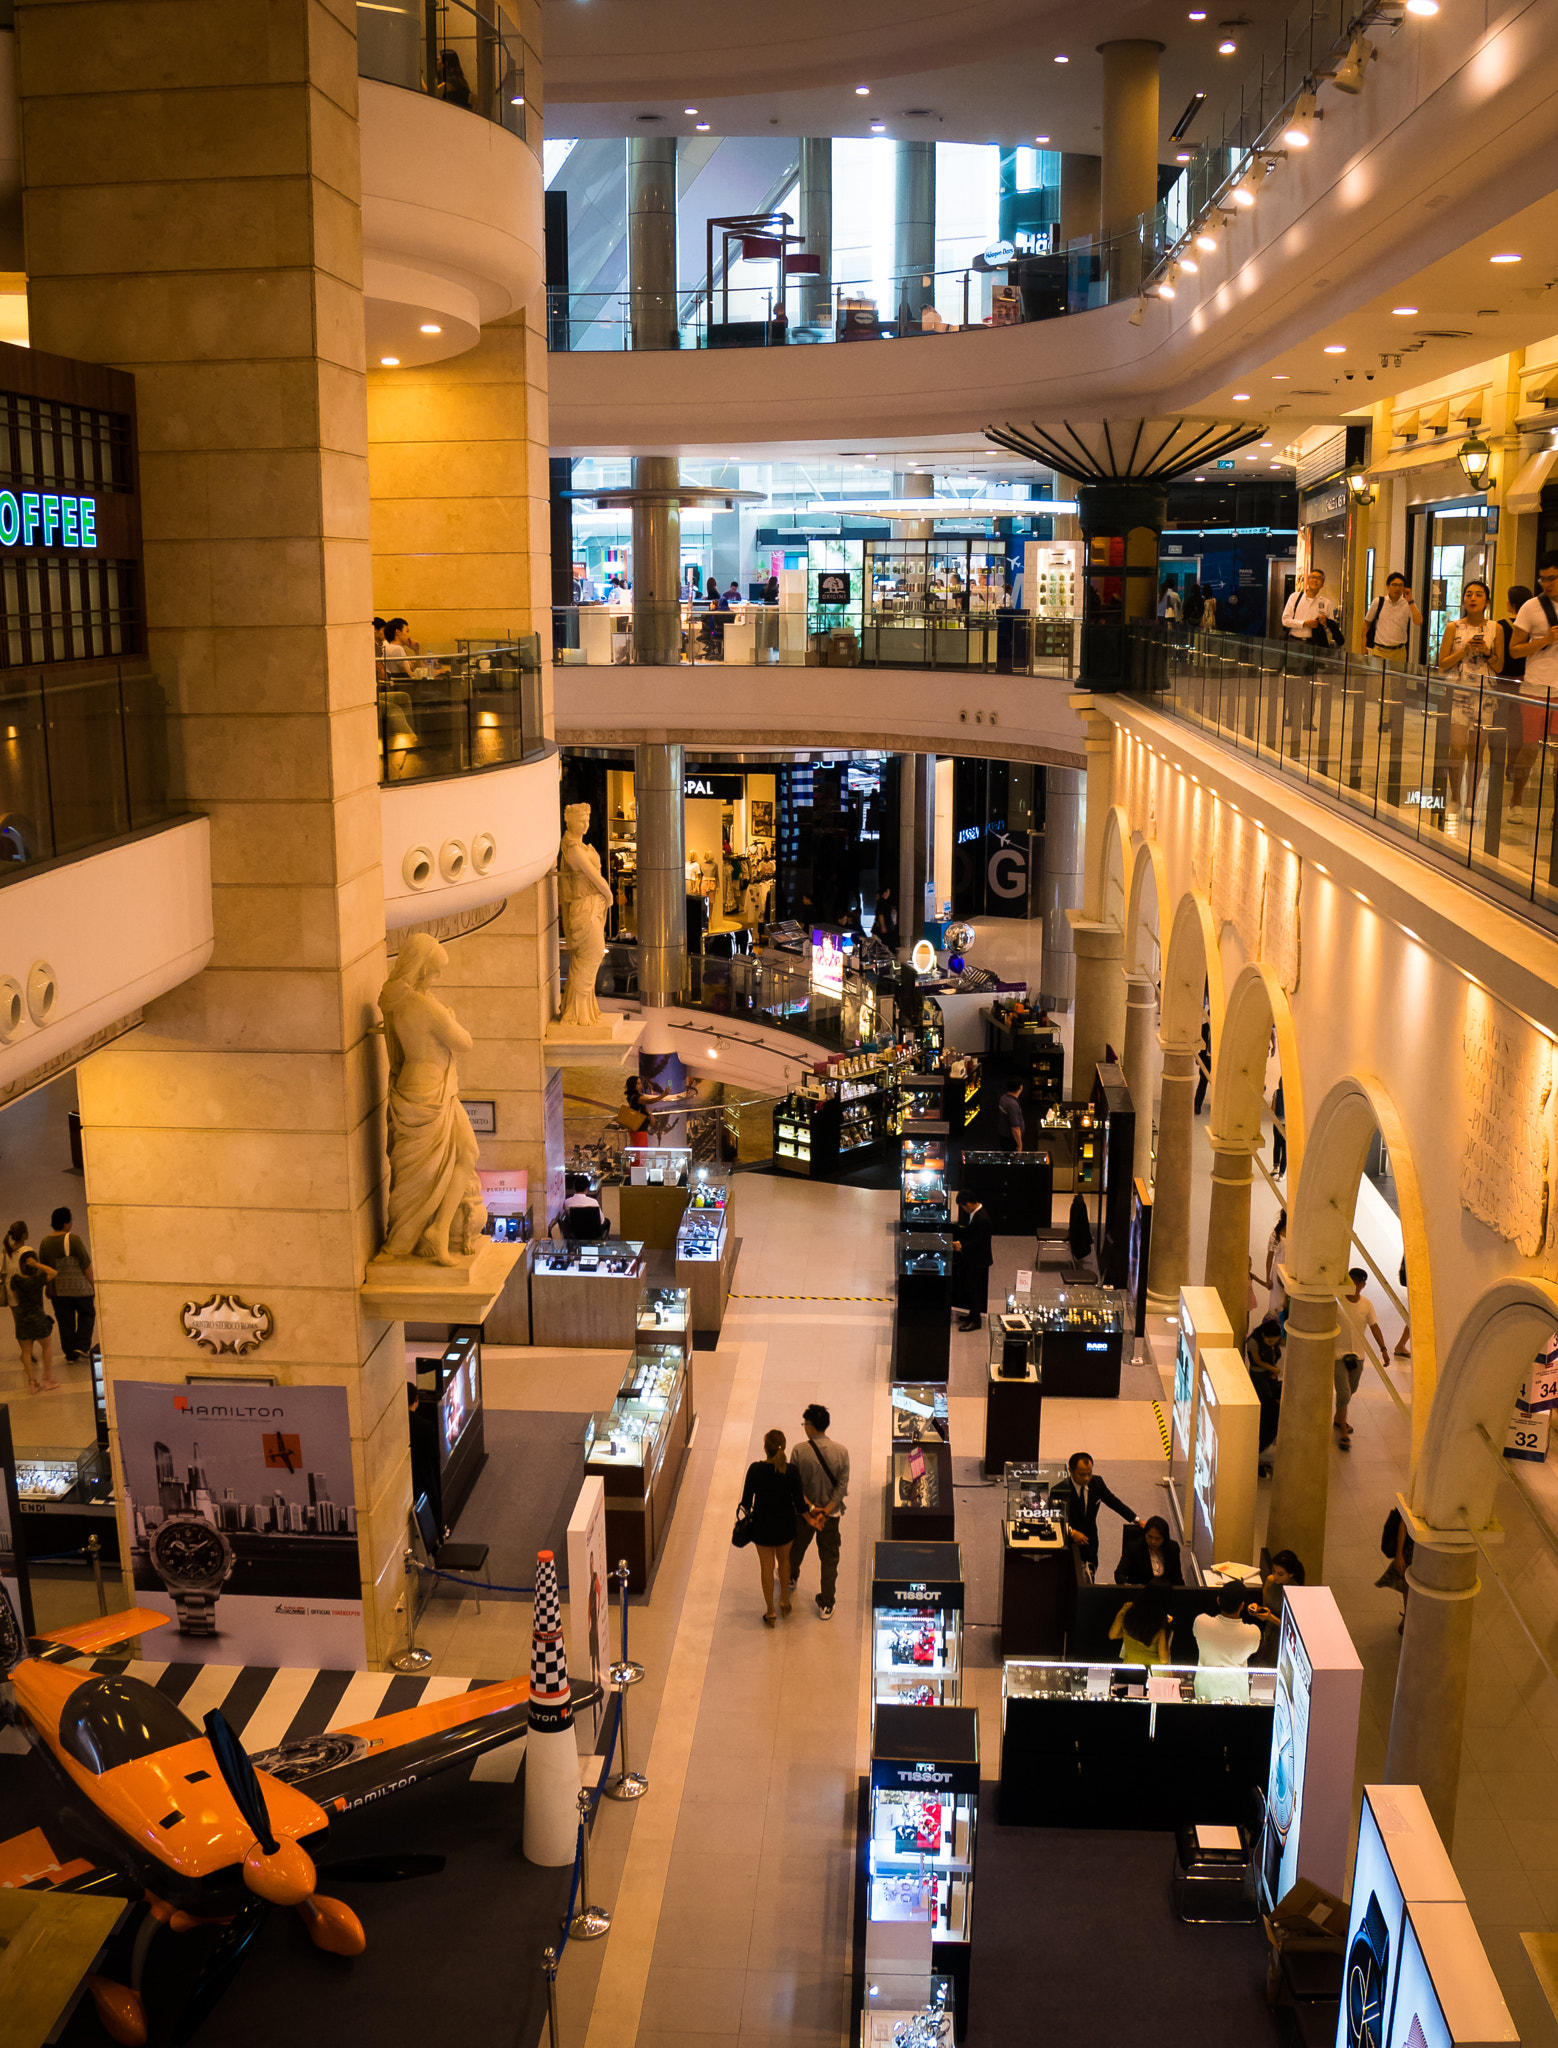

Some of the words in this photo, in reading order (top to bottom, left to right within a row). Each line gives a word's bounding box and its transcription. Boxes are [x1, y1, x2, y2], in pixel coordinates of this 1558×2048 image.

[192, 1320, 215, 1329] CENTRO
[216, 1321, 240, 1330] STORICO
[240, 1322, 259, 1330] ROMA
[1540, 1381, 1557, 1398] 34
[181, 1405, 284, 1418] HAMILTON
[1514, 1431, 1538, 1448] 32
[894, 1590, 942, 1601] TISSOT
[897, 1770, 953, 1783] TISSOT
[342, 1774, 417, 1813] HAMILTON
